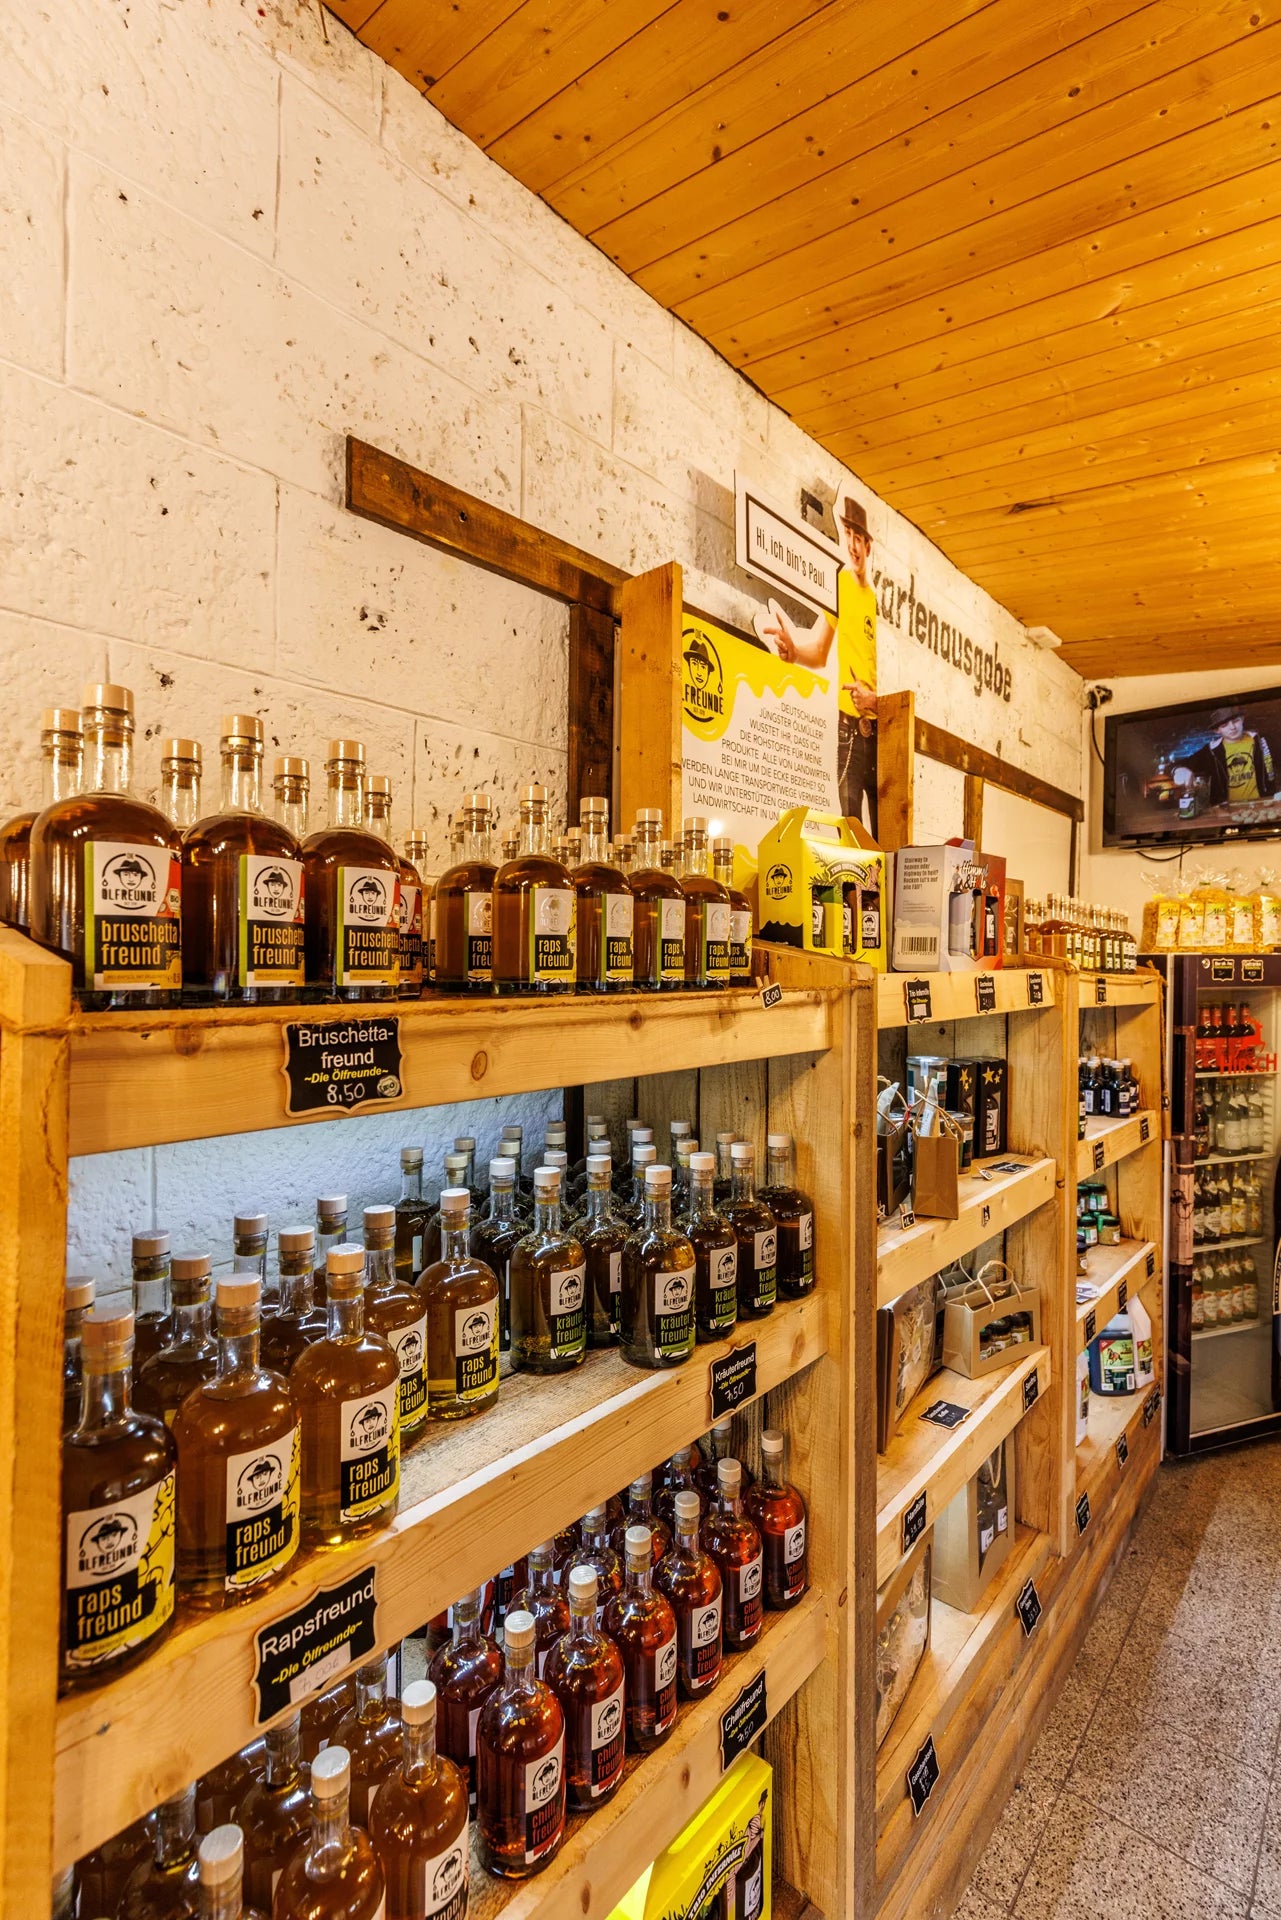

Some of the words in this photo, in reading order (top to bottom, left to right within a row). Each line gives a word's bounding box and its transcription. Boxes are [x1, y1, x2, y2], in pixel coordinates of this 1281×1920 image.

[756, 526, 768, 552] Hi,
[770, 535, 784, 560] ich
[786, 546, 807, 577] bin's
[682, 683, 725, 715] FREUNDE
[759, 707, 792, 727] JÜNGSTER
[781, 702, 827, 729] DEUTSCHLANDS
[749, 718, 780, 737] WUSSTET
[794, 735, 809, 748] DASS
[810, 740, 820, 752] ICH
[722, 739, 759, 760] PRODUKTE
[762, 752, 777, 765] ALLE
[779, 756, 792, 769] VON
[794, 762, 831, 781] LANDWIRTEN
[740, 730, 752, 741] DIE
[753, 735, 791, 756] ROHSTOFFE
[791, 746, 803, 759] FÜR
[804, 753, 822, 766] MEINE
[721, 754, 732, 765] BEI
[735, 757, 747, 768] MIR
[748, 761, 759, 773] UM
[761, 765, 772, 777] DIE
[773, 769, 789, 782] ECKE
[817, 782, 826, 793] SO
[688, 776, 707, 789] UND
[708, 781, 723, 793] WIR
[724, 784, 776, 807] UNTERSTÜTZEN
[714, 768, 740, 783] LANGE
[741, 774, 798, 798] TRANSPORTWEGE
[799, 791, 831, 807] VERMIEDEN
[692, 792, 758, 817] LANDWIRTSCHAFT
[760, 809, 768, 818] IN
[101, 920, 178, 943] bruschetta
[101, 944, 161, 966] freund
[253, 946, 296, 965] freund
[348, 950, 389, 966] freund
[539, 939, 561, 954] raps
[609, 941, 627, 955] raps
[664, 943, 680, 955] raps
[709, 944, 725, 956] raps
[539, 952, 570, 967] freund
[609, 953, 632, 967] freund
[298, 1026, 394, 1047] Bruschetta-
[321, 1048, 374, 1069] freund
[660, 1313, 690, 1331] kräuter
[660, 1326, 688, 1344] freund
[462, 1356, 485, 1374] raps
[462, 1364, 493, 1388] freund
[715, 1352, 755, 1383] Kräuterfreund
[400, 1378, 418, 1398] aps
[401, 1387, 425, 1414] reund
[350, 1458, 379, 1478] raps
[349, 1465, 391, 1502] freund
[236, 1517, 271, 1546] raps
[236, 1526, 285, 1568] freund
[78, 1584, 123, 1616] raps
[78, 1593, 143, 1641] freund
[261, 1578, 375, 1664] Rapsfreund
[725, 1680, 763, 1731] Chillifreund
